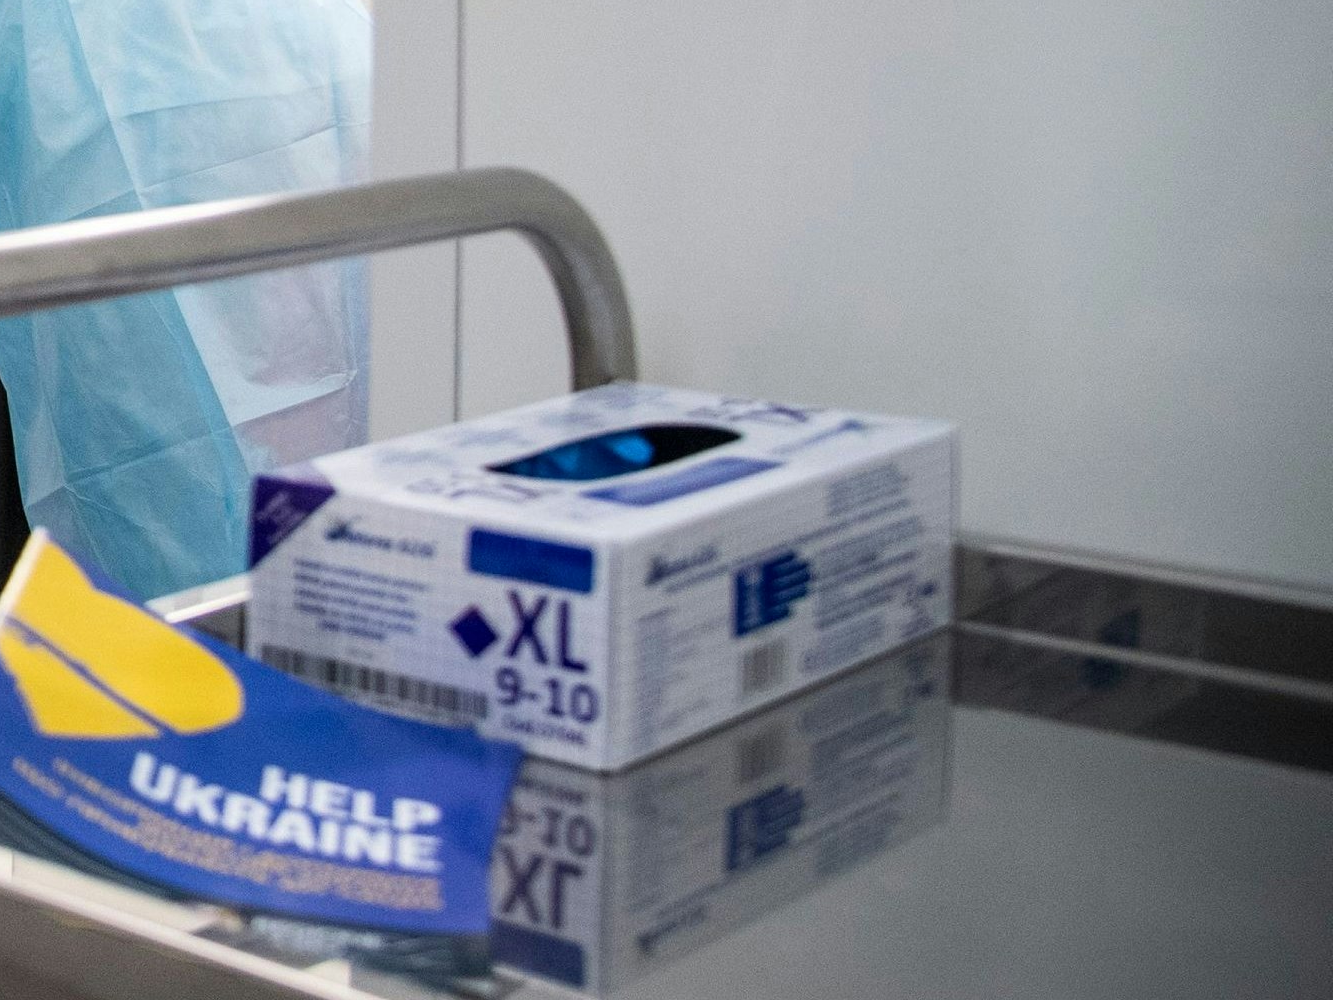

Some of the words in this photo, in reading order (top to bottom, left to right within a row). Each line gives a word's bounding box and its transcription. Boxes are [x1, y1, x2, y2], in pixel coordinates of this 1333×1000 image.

[506, 590, 588, 672] XL
[495, 666, 599, 725] 9-10
[129, 751, 444, 873] UKRAINE
[260, 764, 441, 832] HELP
